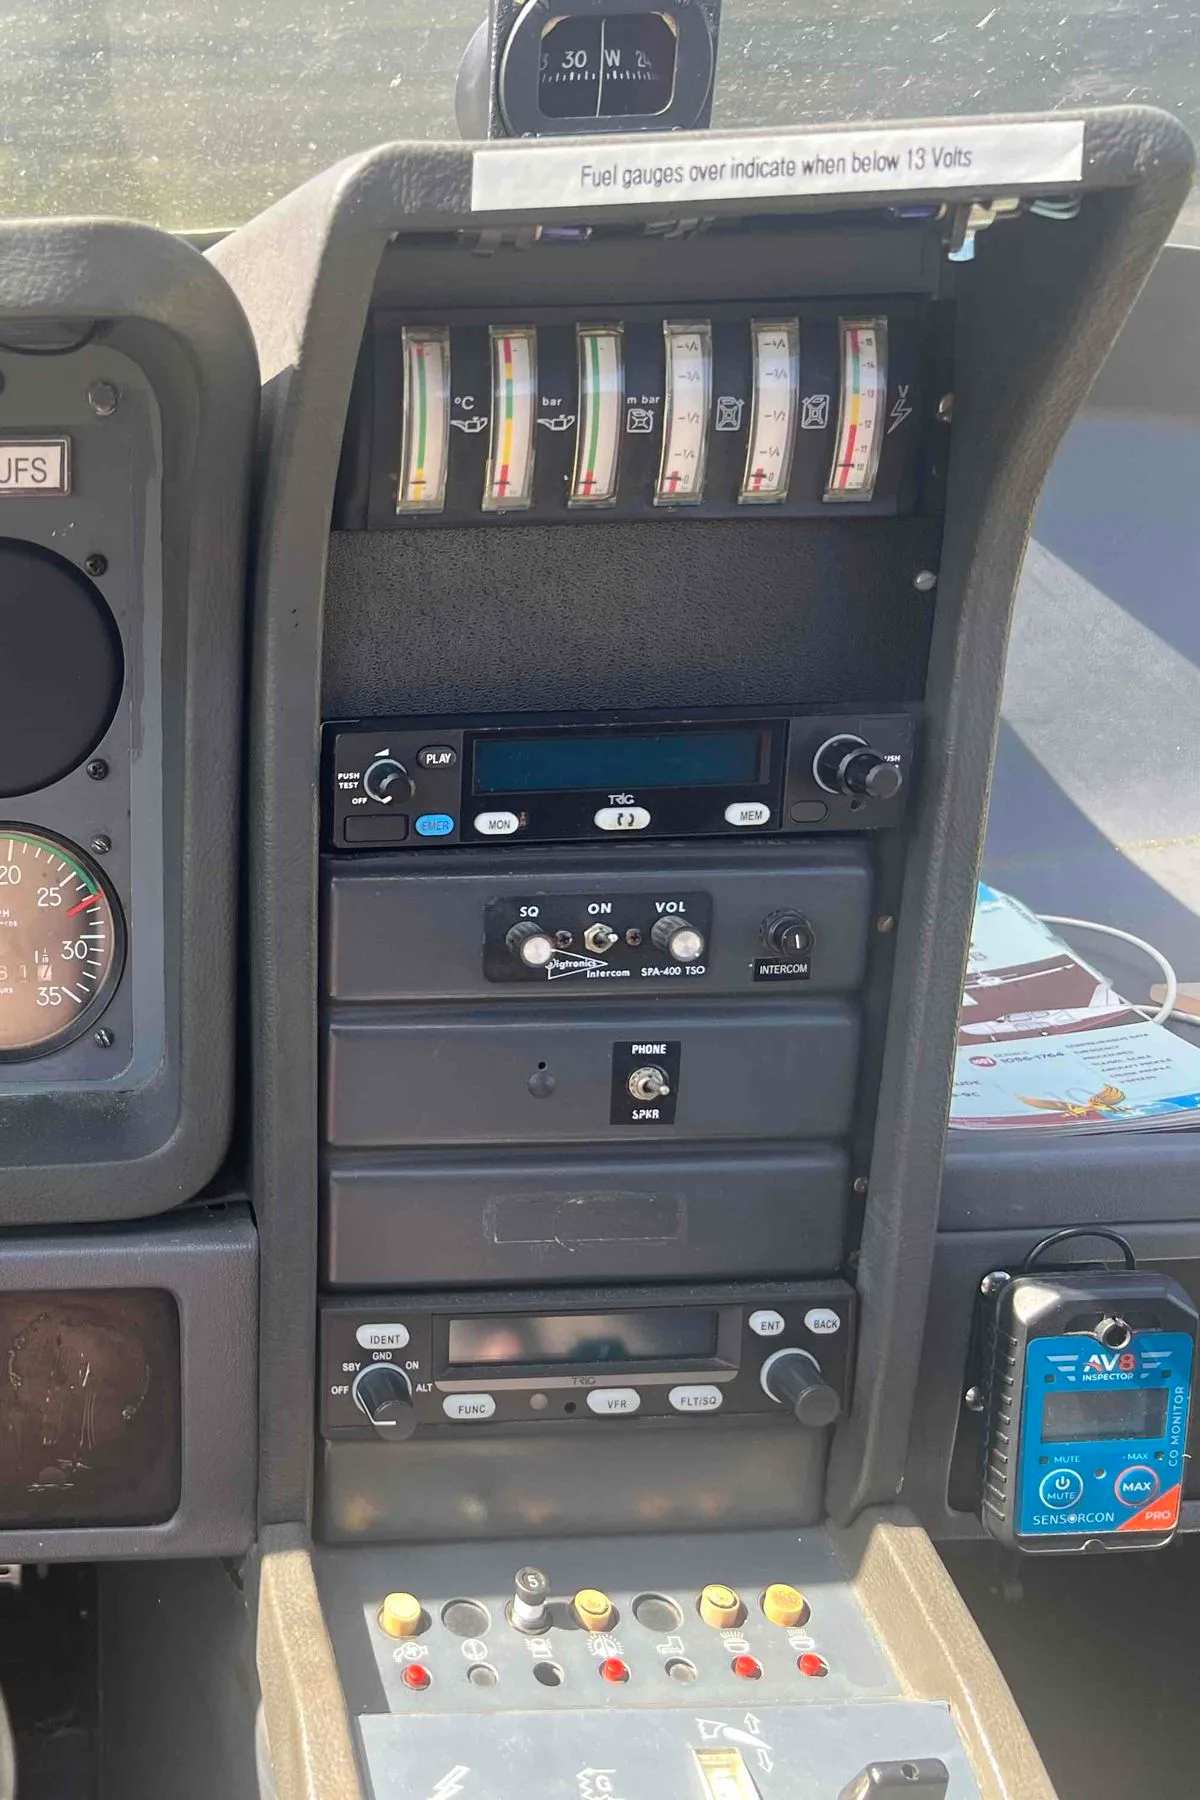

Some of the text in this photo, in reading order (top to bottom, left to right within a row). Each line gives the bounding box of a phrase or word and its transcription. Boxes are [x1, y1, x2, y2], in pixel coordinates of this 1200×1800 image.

[561, 50, 587, 69] 30
[605, 50, 621, 67] W
[580, 146, 972, 189] Fuel gauges over indicate when below 13 Volts
[542, 397, 563, 407] bar
[627, 395, 661, 405] m bar
[426, 752, 452, 765] PLAY
[337, 772, 360, 780] PUSH
[338, 781, 359, 789] TEST
[351, 797, 368, 805] OFF
[608, 792, 635, 805] TRIG
[739, 810, 763, 821] MEM
[422, 820, 449, 831] EMER
[488, 819, 511, 831] MON
[37, 887, 62, 908] 25
[519, 906, 540, 917] SQ
[587, 902, 612, 914] ON
[655, 901, 686, 913] VOL
[60, 940, 88, 960] 30
[586, 969, 631, 979] Intercom
[641, 965, 705, 977] SPA-400 TSO
[759, 964, 808, 976] INTERCOM
[36, 986, 62, 1006] 35
[631, 1044, 667, 1055] PHONE
[631, 1109, 660, 1120] SPKR
[760, 1320, 782, 1331] ENT
[813, 1319, 839, 1330] BACK
[369, 1334, 401, 1345] IDENT
[372, 1351, 393, 1361] GND
[342, 1363, 362, 1372] SBY
[405, 1361, 420, 1371] ON
[1081, 1353, 1137, 1373] AV8
[1081, 1372, 1134, 1382] INSPECTOR
[331, 1385, 349, 1395] OFF
[415, 1383, 433, 1393] ALT
[607, 1399, 627, 1410] VFR
[680, 1396, 717, 1407] FLT/SQ
[458, 1404, 487, 1415] FUNC
[1169, 1386, 1184, 1467] CO MONITOR
[1054, 1455, 1081, 1463] MUTE
[1127, 1452, 1149, 1461] MAX
[1122, 1481, 1152, 1492] MAX
[1047, 1491, 1076, 1501] MUTE
[1032, 1511, 1116, 1527] SENSORCON
[1145, 1509, 1172, 1520] PRO
[527, 1574, 539, 1588] 5
